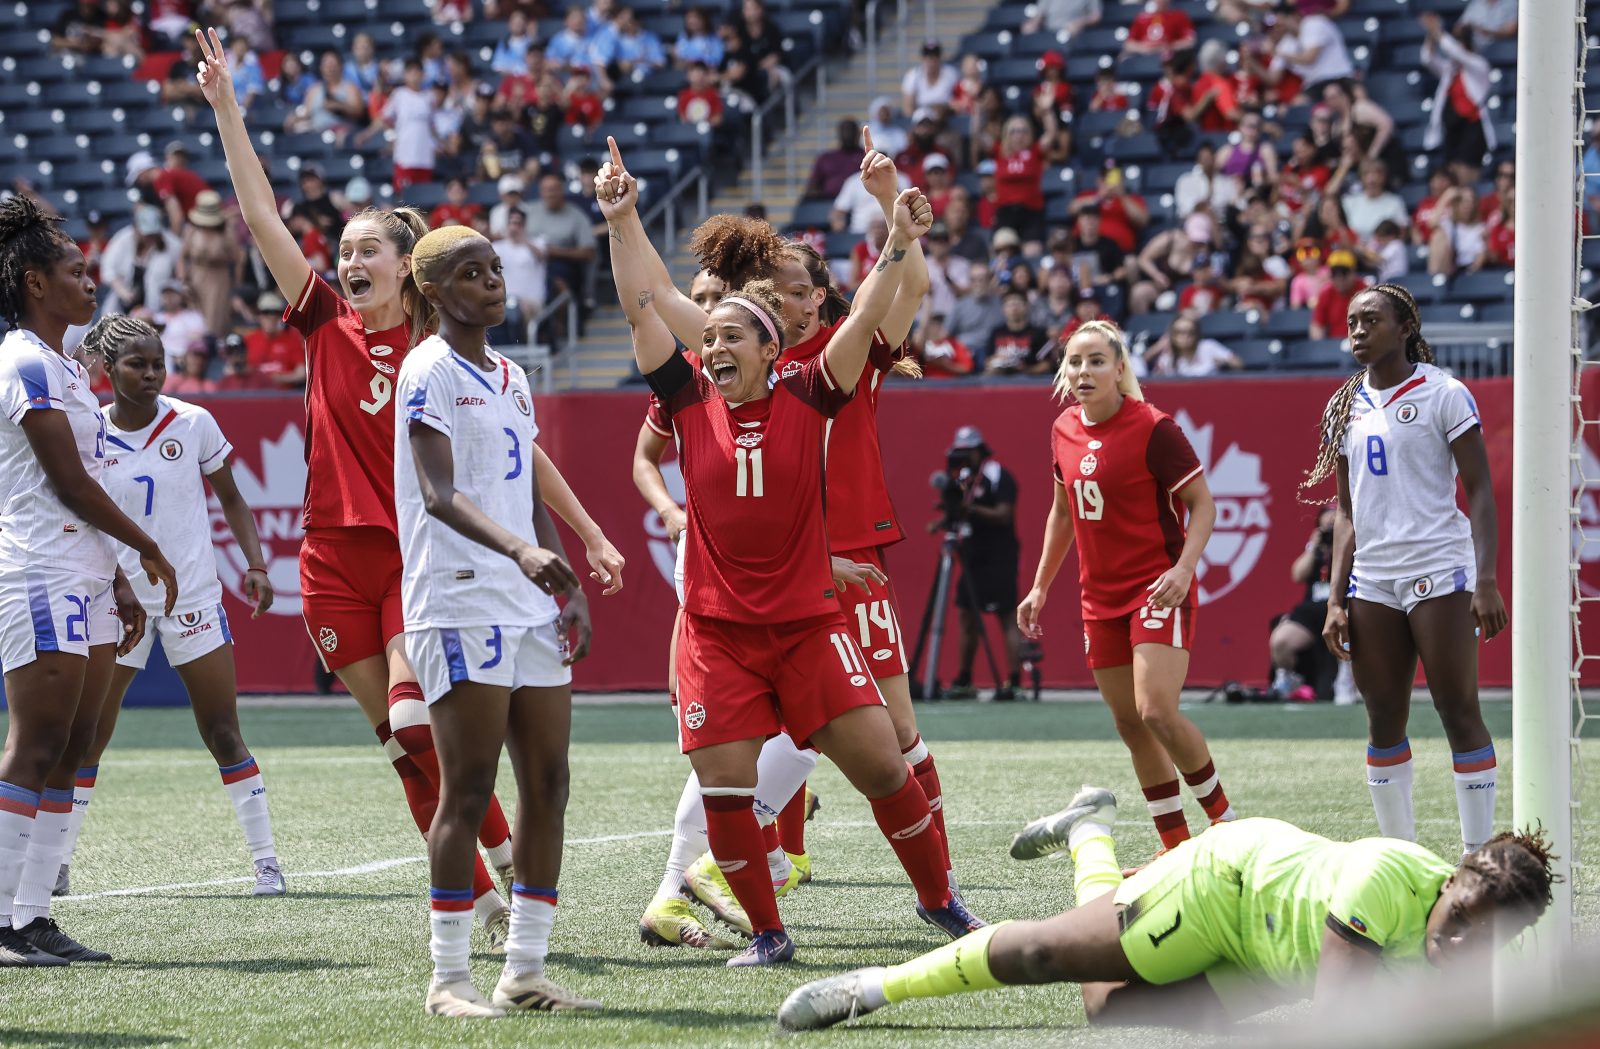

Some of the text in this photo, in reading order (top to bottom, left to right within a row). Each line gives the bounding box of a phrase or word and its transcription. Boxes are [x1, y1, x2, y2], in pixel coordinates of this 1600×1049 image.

[360, 372, 391, 416] 9
[455, 396, 487, 407] SAETA
[503, 427, 522, 480] 3
[735, 447, 764, 497] 11
[1367, 435, 1388, 476] 8
[134, 475, 155, 516] 7
[1073, 479, 1105, 521] 19
[179, 623, 212, 639] SAETA
[854, 599, 897, 648] 14
[478, 625, 502, 669] 3
[830, 632, 863, 674] 11
